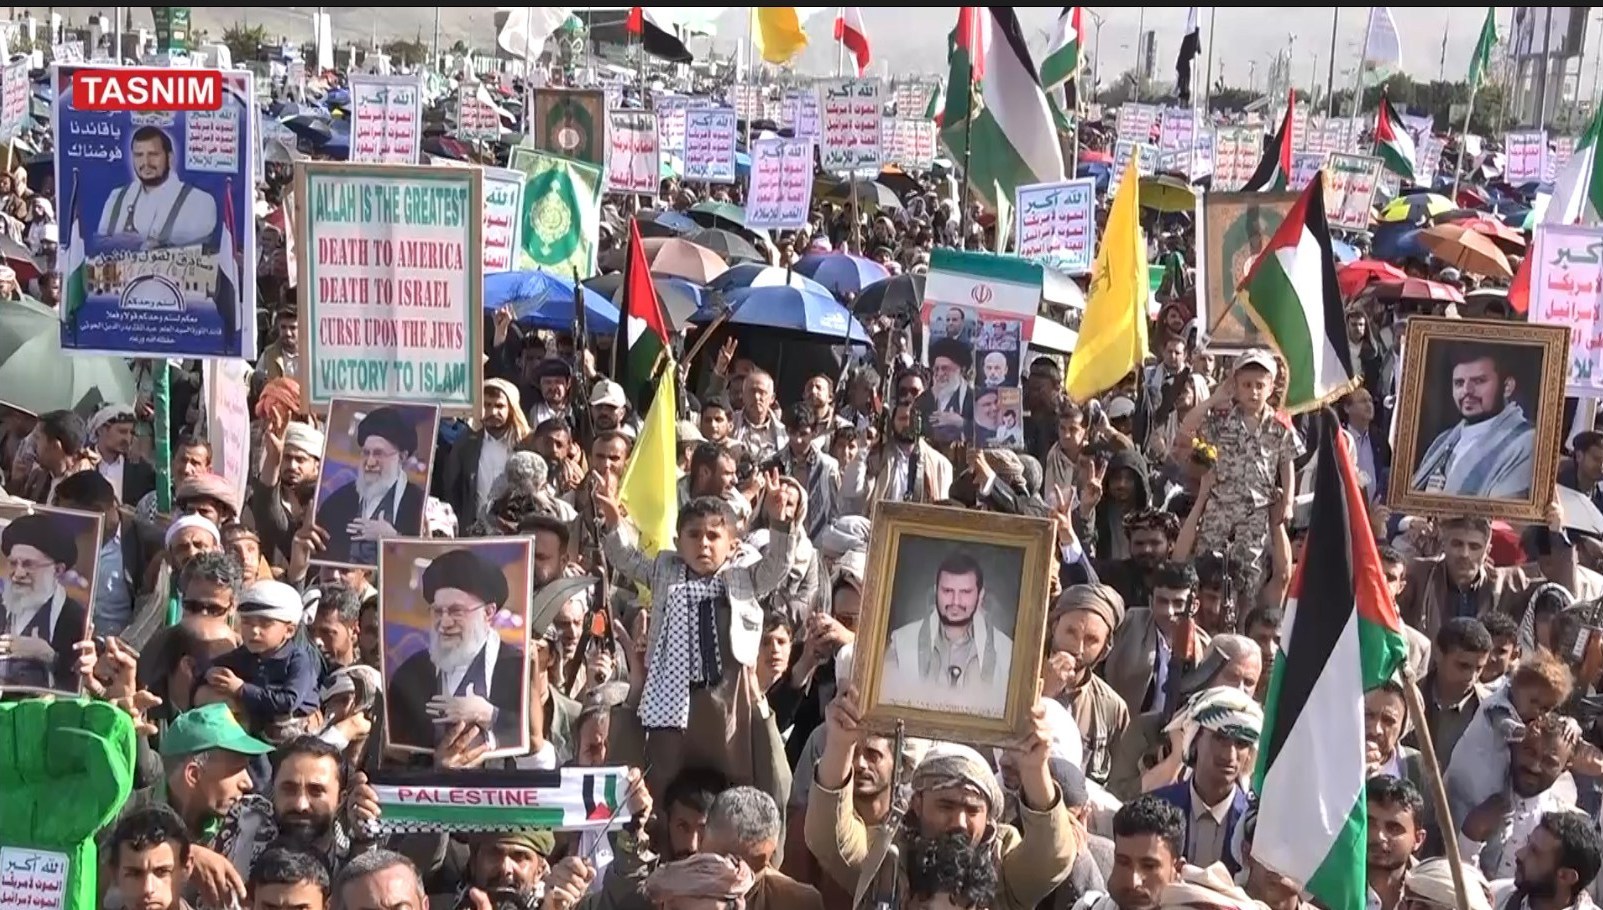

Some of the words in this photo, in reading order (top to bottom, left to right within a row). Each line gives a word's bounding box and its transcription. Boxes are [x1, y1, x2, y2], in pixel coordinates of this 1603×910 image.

[316, 183, 356, 222] ALLAH
[360, 183, 372, 223] IS
[375, 185, 400, 224] THE
[404, 186, 467, 227] GREATEST
[318, 237, 369, 266] DEATH
[373, 239, 393, 267] TO
[397, 241, 463, 270] AMERICA
[319, 277, 369, 304] DEATH
[374, 278, 393, 305] TO
[398, 279, 451, 308] ISRAEL
[320, 317, 361, 346] CURSE
[365, 318, 398, 347] UPON
[402, 320, 427, 348] THE
[430, 321, 463, 350] JEWS
[321, 359, 388, 391] VICTORY
[394, 361, 413, 392] TO
[420, 362, 466, 393] ISLAM
[398, 789, 539, 806] PALESTINE
[4, 853, 41, 874] أكبر
[41, 857, 64, 873] الله
